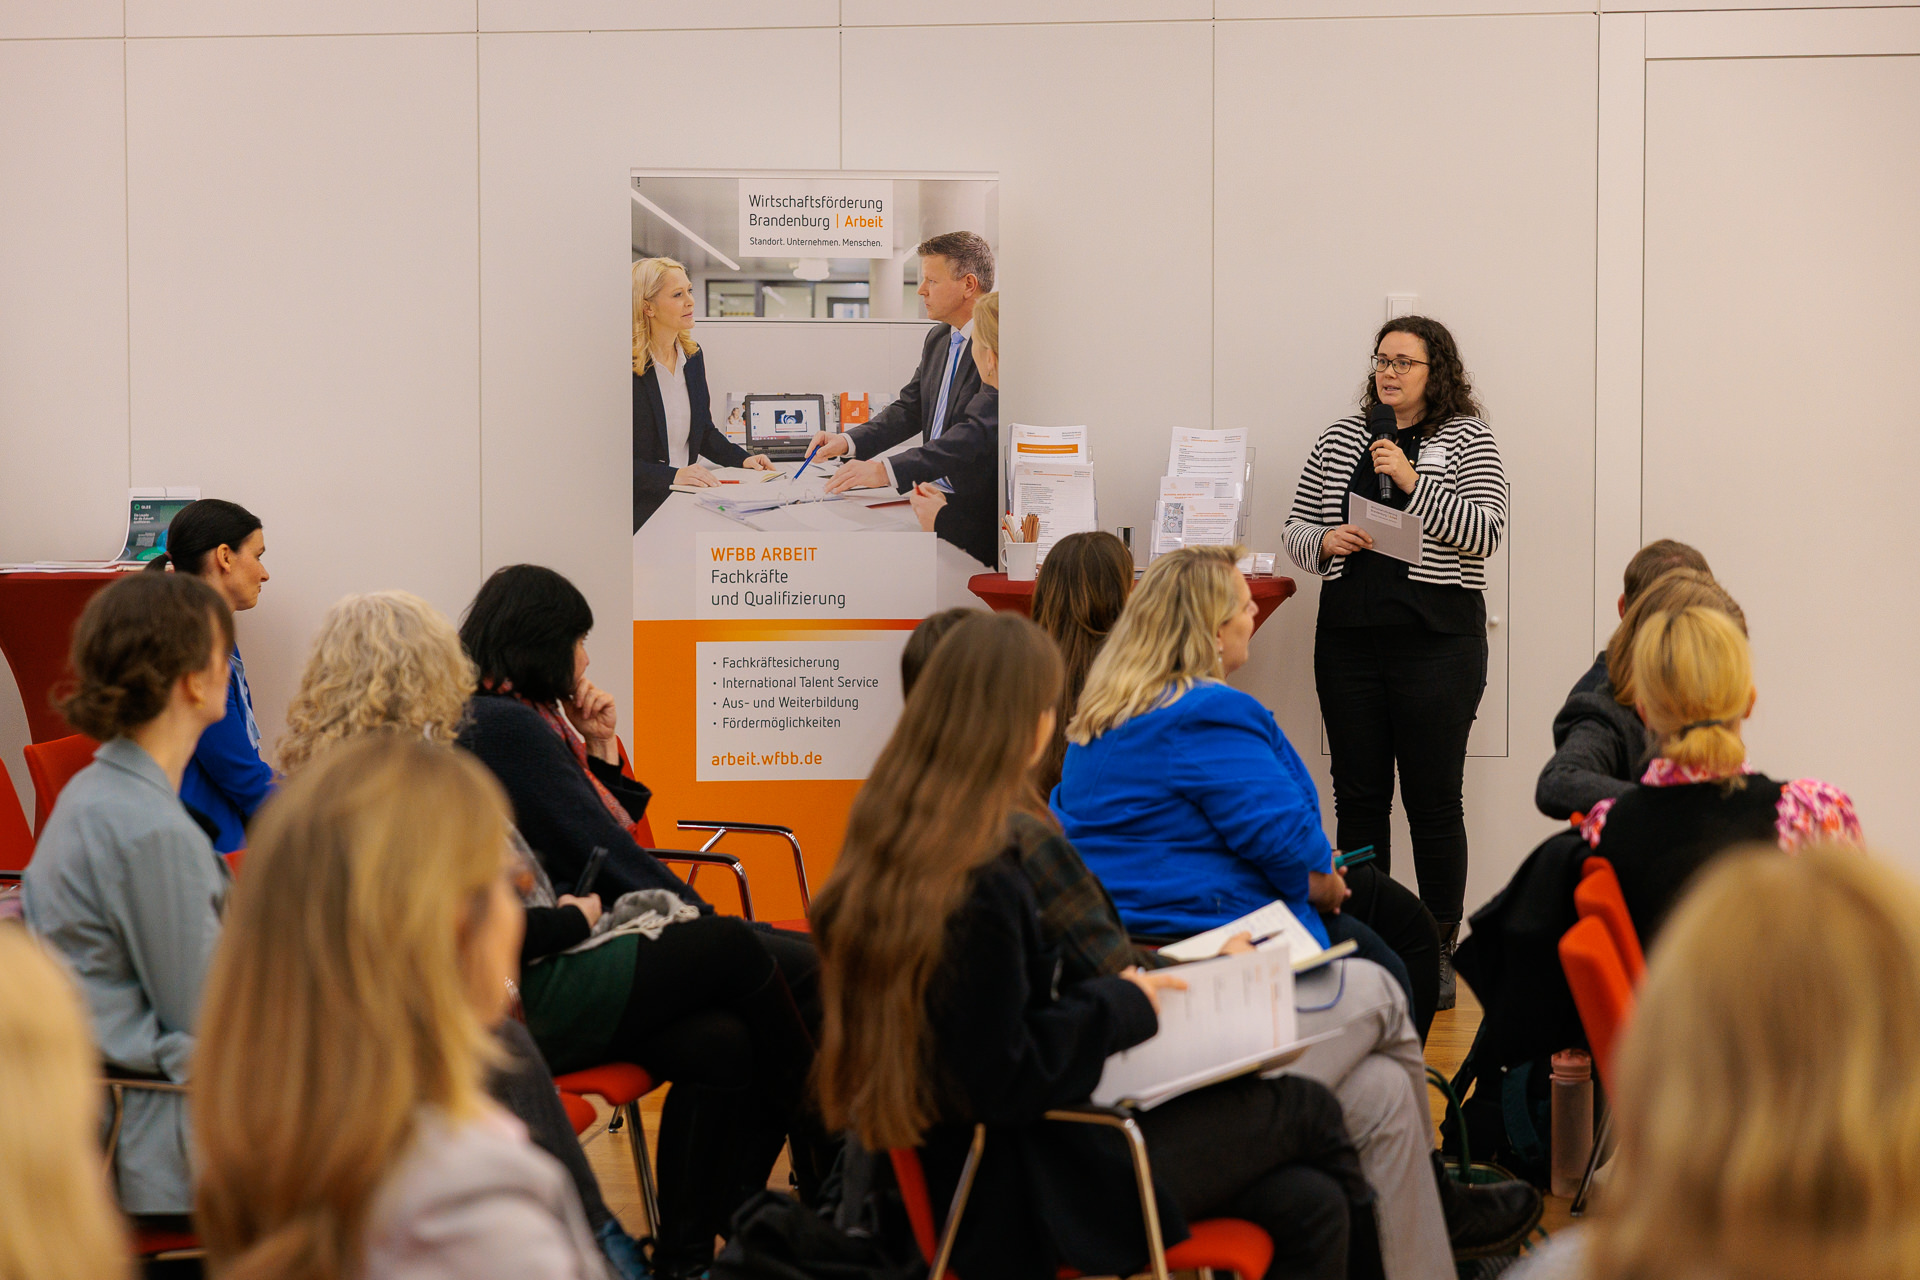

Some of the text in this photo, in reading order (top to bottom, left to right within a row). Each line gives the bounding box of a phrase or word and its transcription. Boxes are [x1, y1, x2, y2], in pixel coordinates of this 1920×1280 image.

[749, 194, 883, 212] Wirtschaftsförderung
[749, 213, 884, 230] Brandenburg Arbeit
[749, 237, 883, 247] Standort. Unternehmen. Menschen.
[711, 547, 818, 561] WFBB ARBEIT
[711, 569, 789, 584] Fachkräfte
[711, 591, 846, 609] und Qualifizierung
[722, 657, 840, 670] Fachkräftesicherung
[722, 676, 879, 688] International Talent Service
[722, 696, 859, 711] Aus- und Weiterbildung
[722, 716, 841, 731] Fördermöglichkeiten
[711, 751, 823, 766] arbeit.wfbb.de
